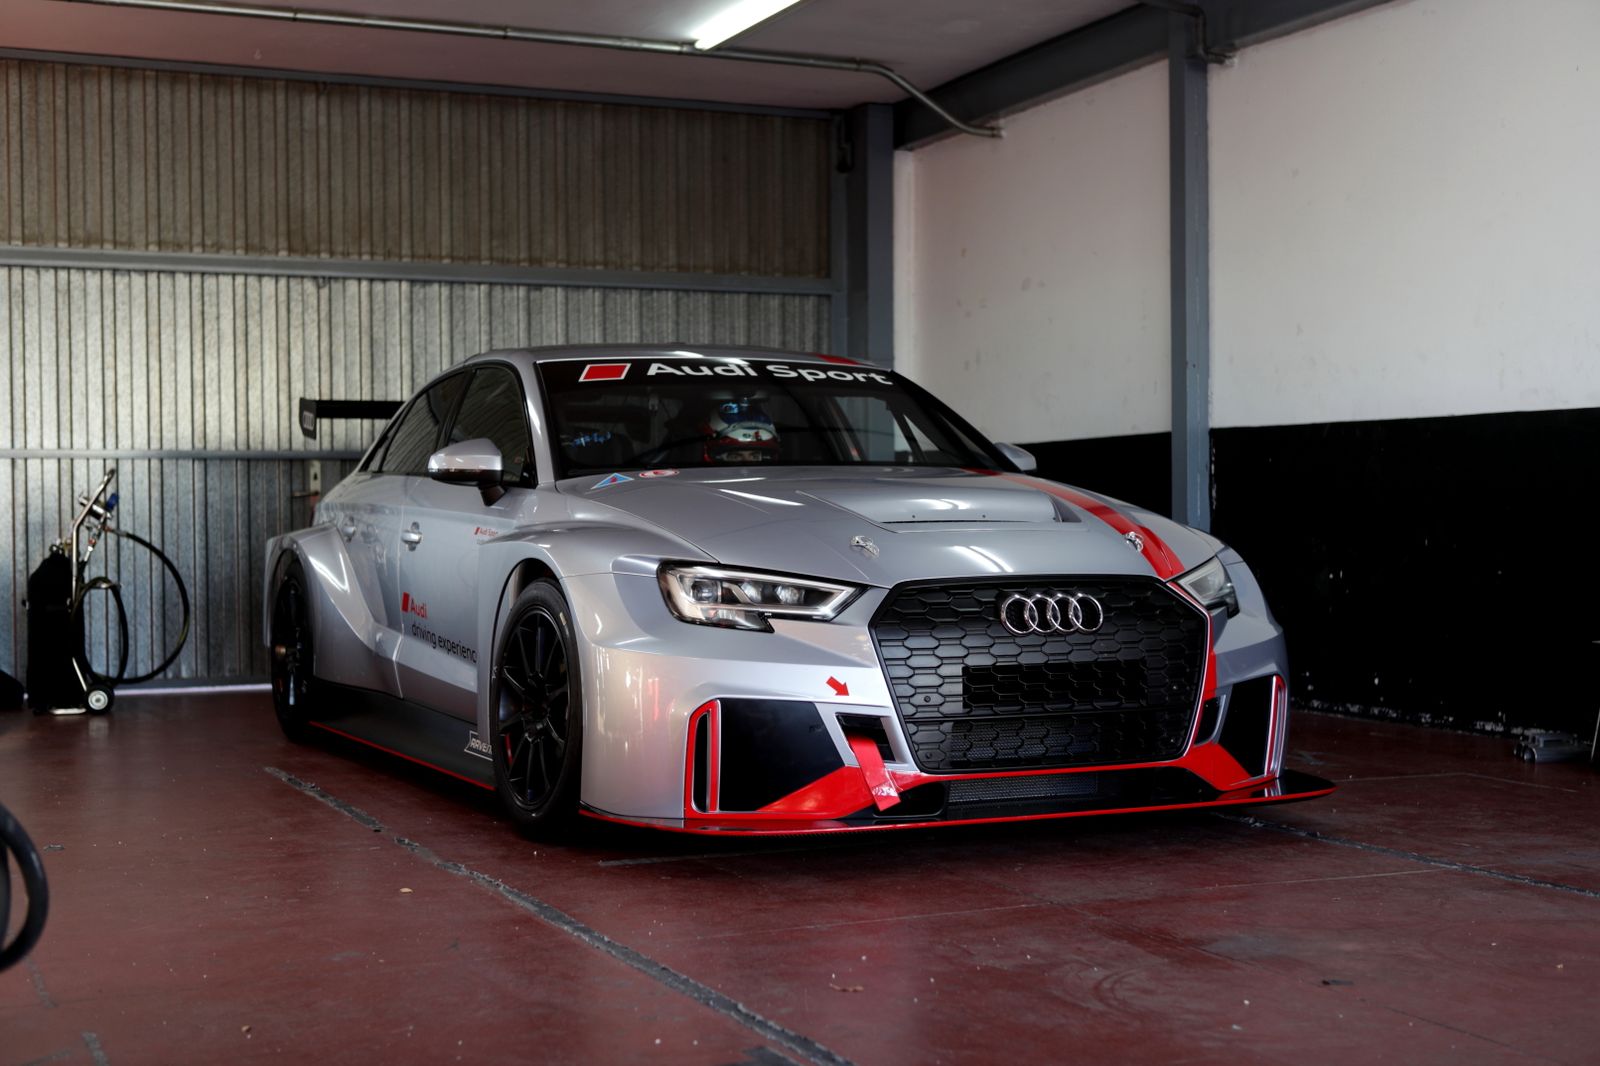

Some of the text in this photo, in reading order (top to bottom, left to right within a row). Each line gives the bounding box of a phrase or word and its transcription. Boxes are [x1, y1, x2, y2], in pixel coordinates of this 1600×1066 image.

[646, 362, 894, 386] Audi Sport
[410, 598, 428, 620] Audi
[412, 622, 477, 664] driving experienc
